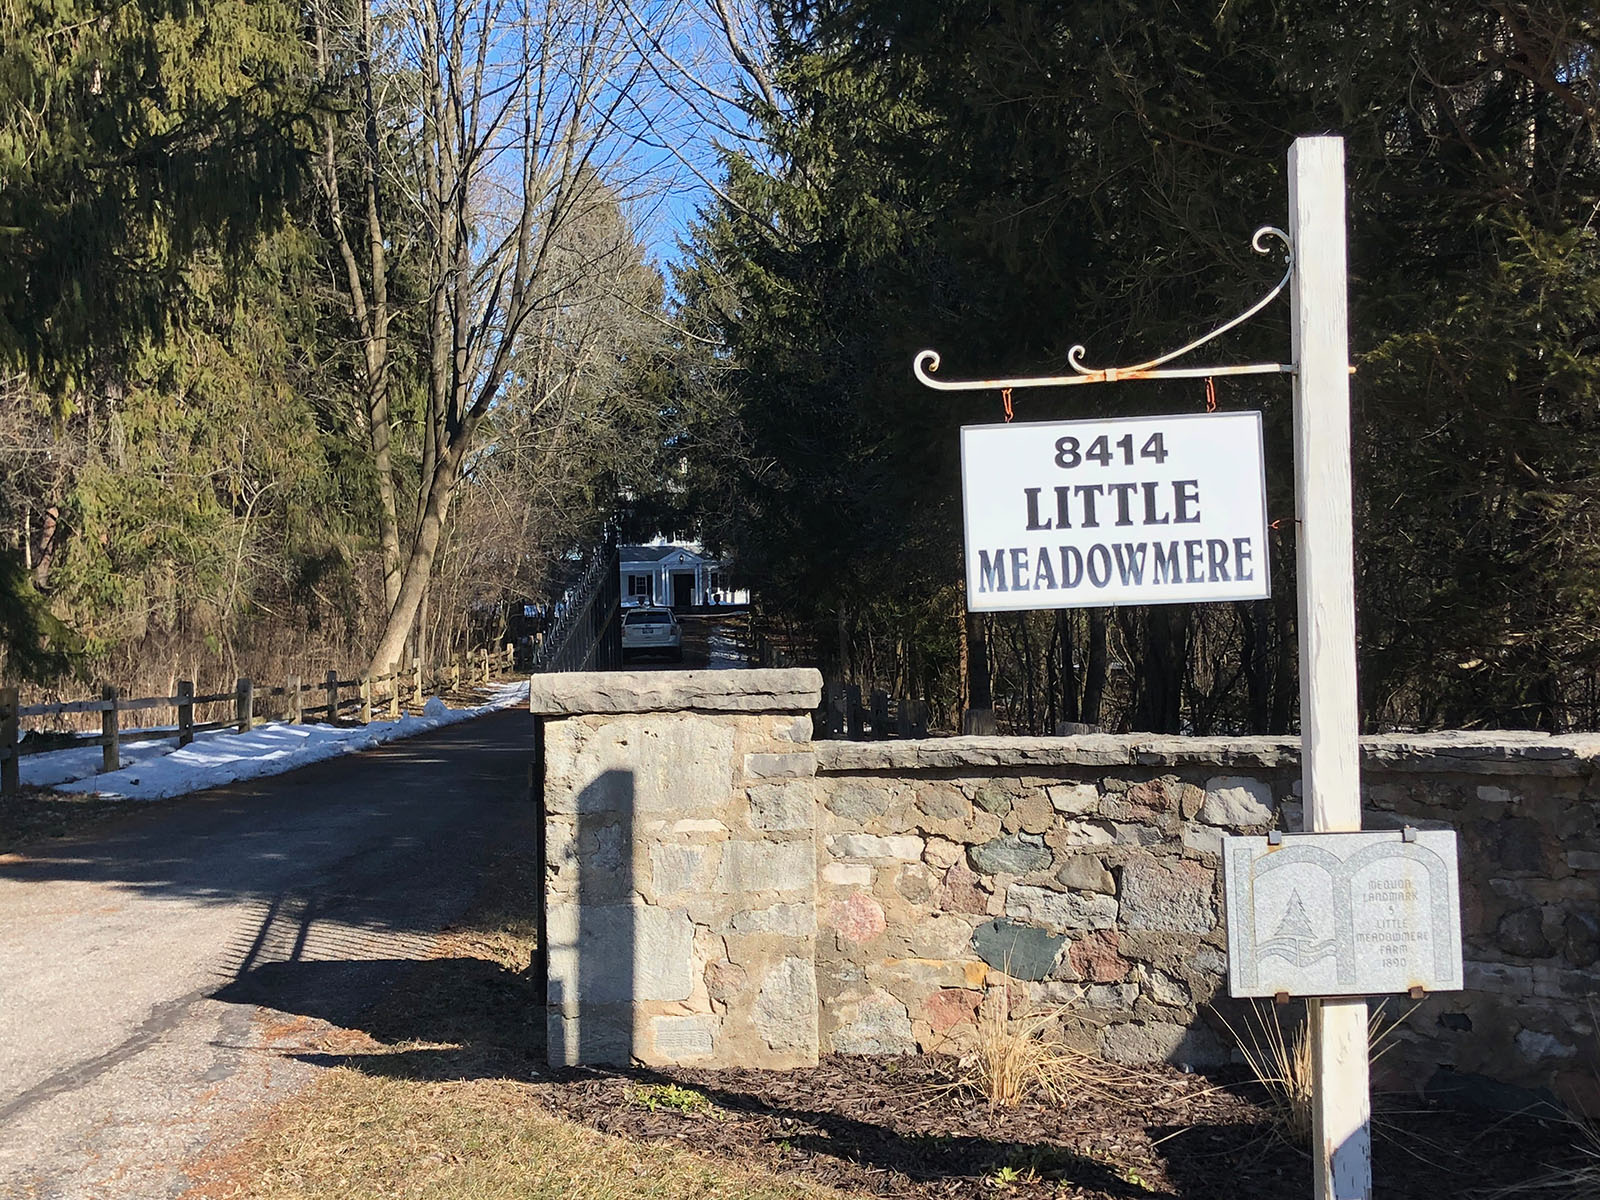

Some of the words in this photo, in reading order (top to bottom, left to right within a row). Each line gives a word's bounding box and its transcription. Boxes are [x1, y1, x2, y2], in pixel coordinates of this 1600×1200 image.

[1054, 432, 1168, 469] 8414
[1024, 480, 1201, 531] LITTLE
[978, 537, 1253, 593] MEADOWMERE
[1368, 879, 1411, 890] MEQUON
[1363, 891, 1418, 903] LANDMARK
[1377, 919, 1408, 929] LITTLE
[1356, 931, 1429, 943] MEADOWMERE
[1380, 944, 1408, 955] FARM
[1382, 957, 1407, 968] 1890
